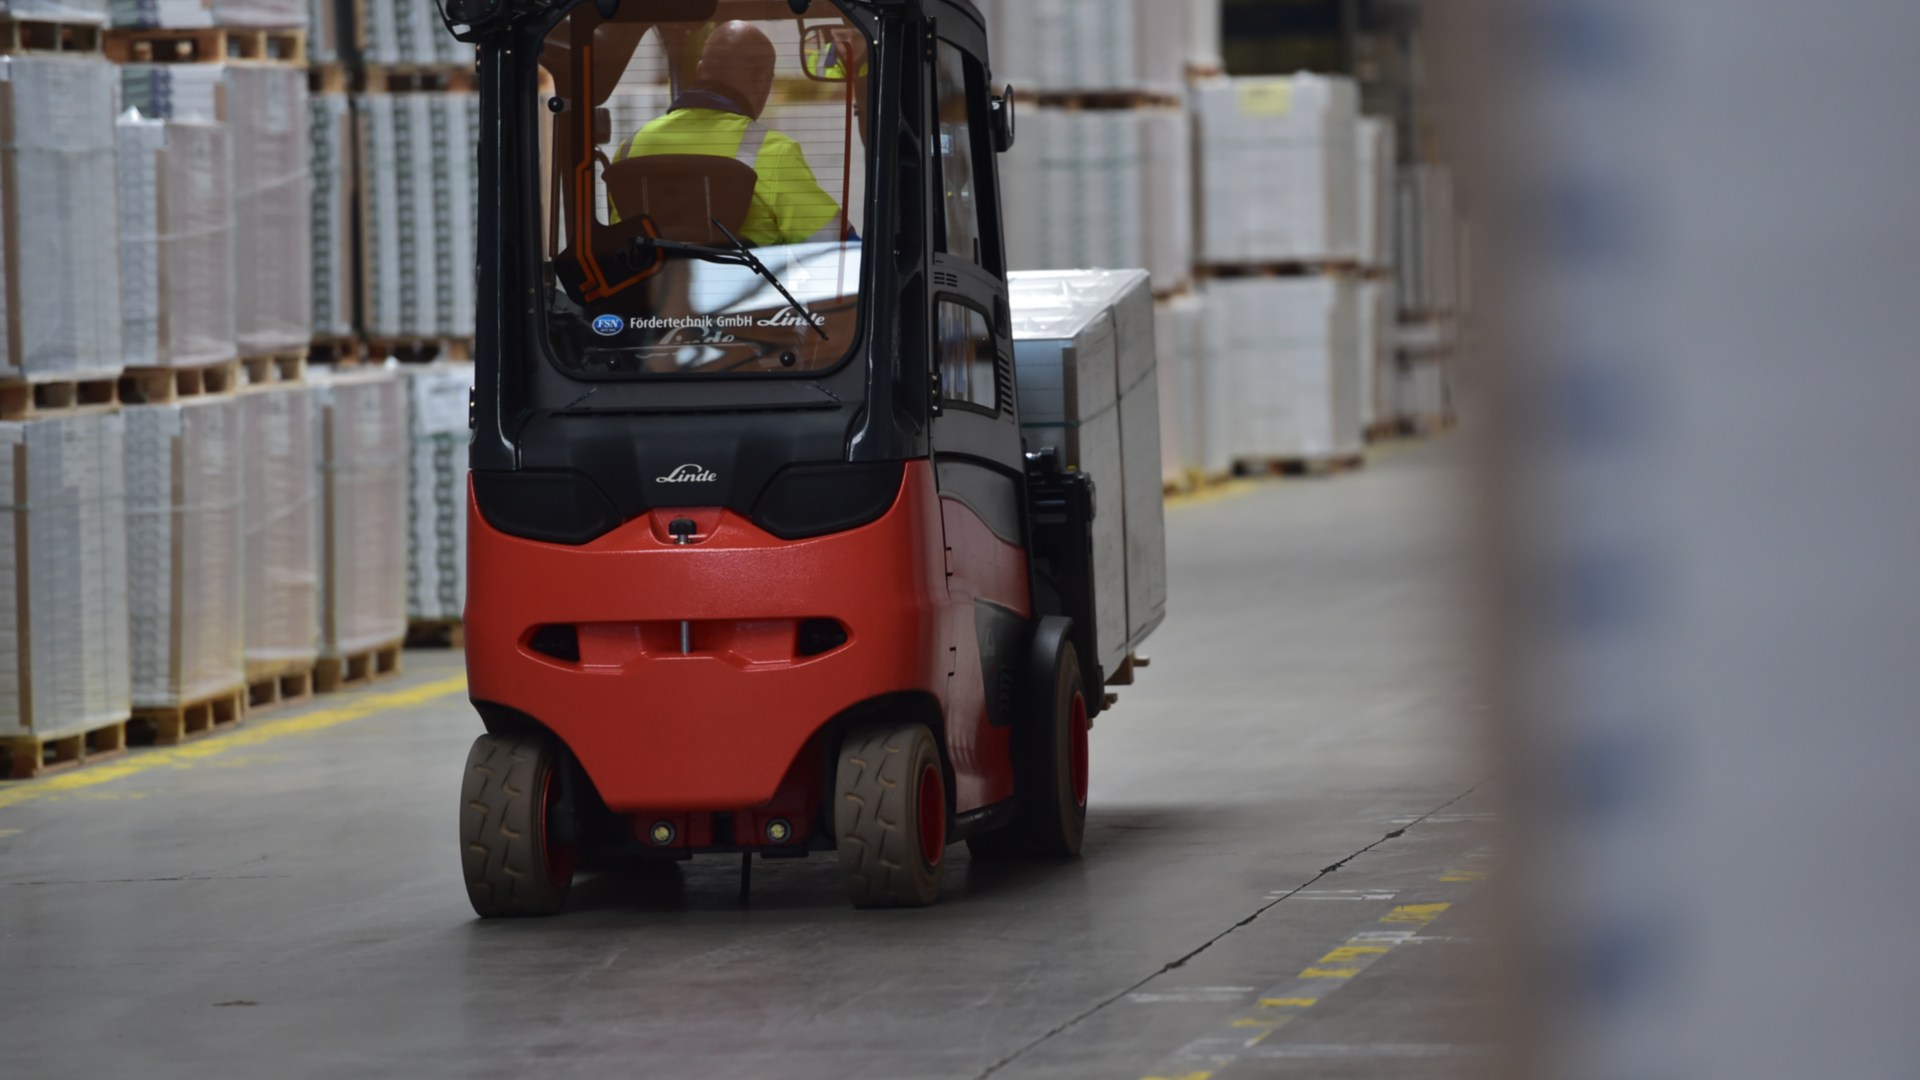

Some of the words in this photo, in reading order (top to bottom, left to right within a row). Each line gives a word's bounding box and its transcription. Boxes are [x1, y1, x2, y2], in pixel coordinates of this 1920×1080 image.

[597, 319, 618, 328] FSN
[630, 315, 713, 329] Fördertechnik
[716, 315, 753, 328] GmbH
[655, 463, 717, 483] Linde
